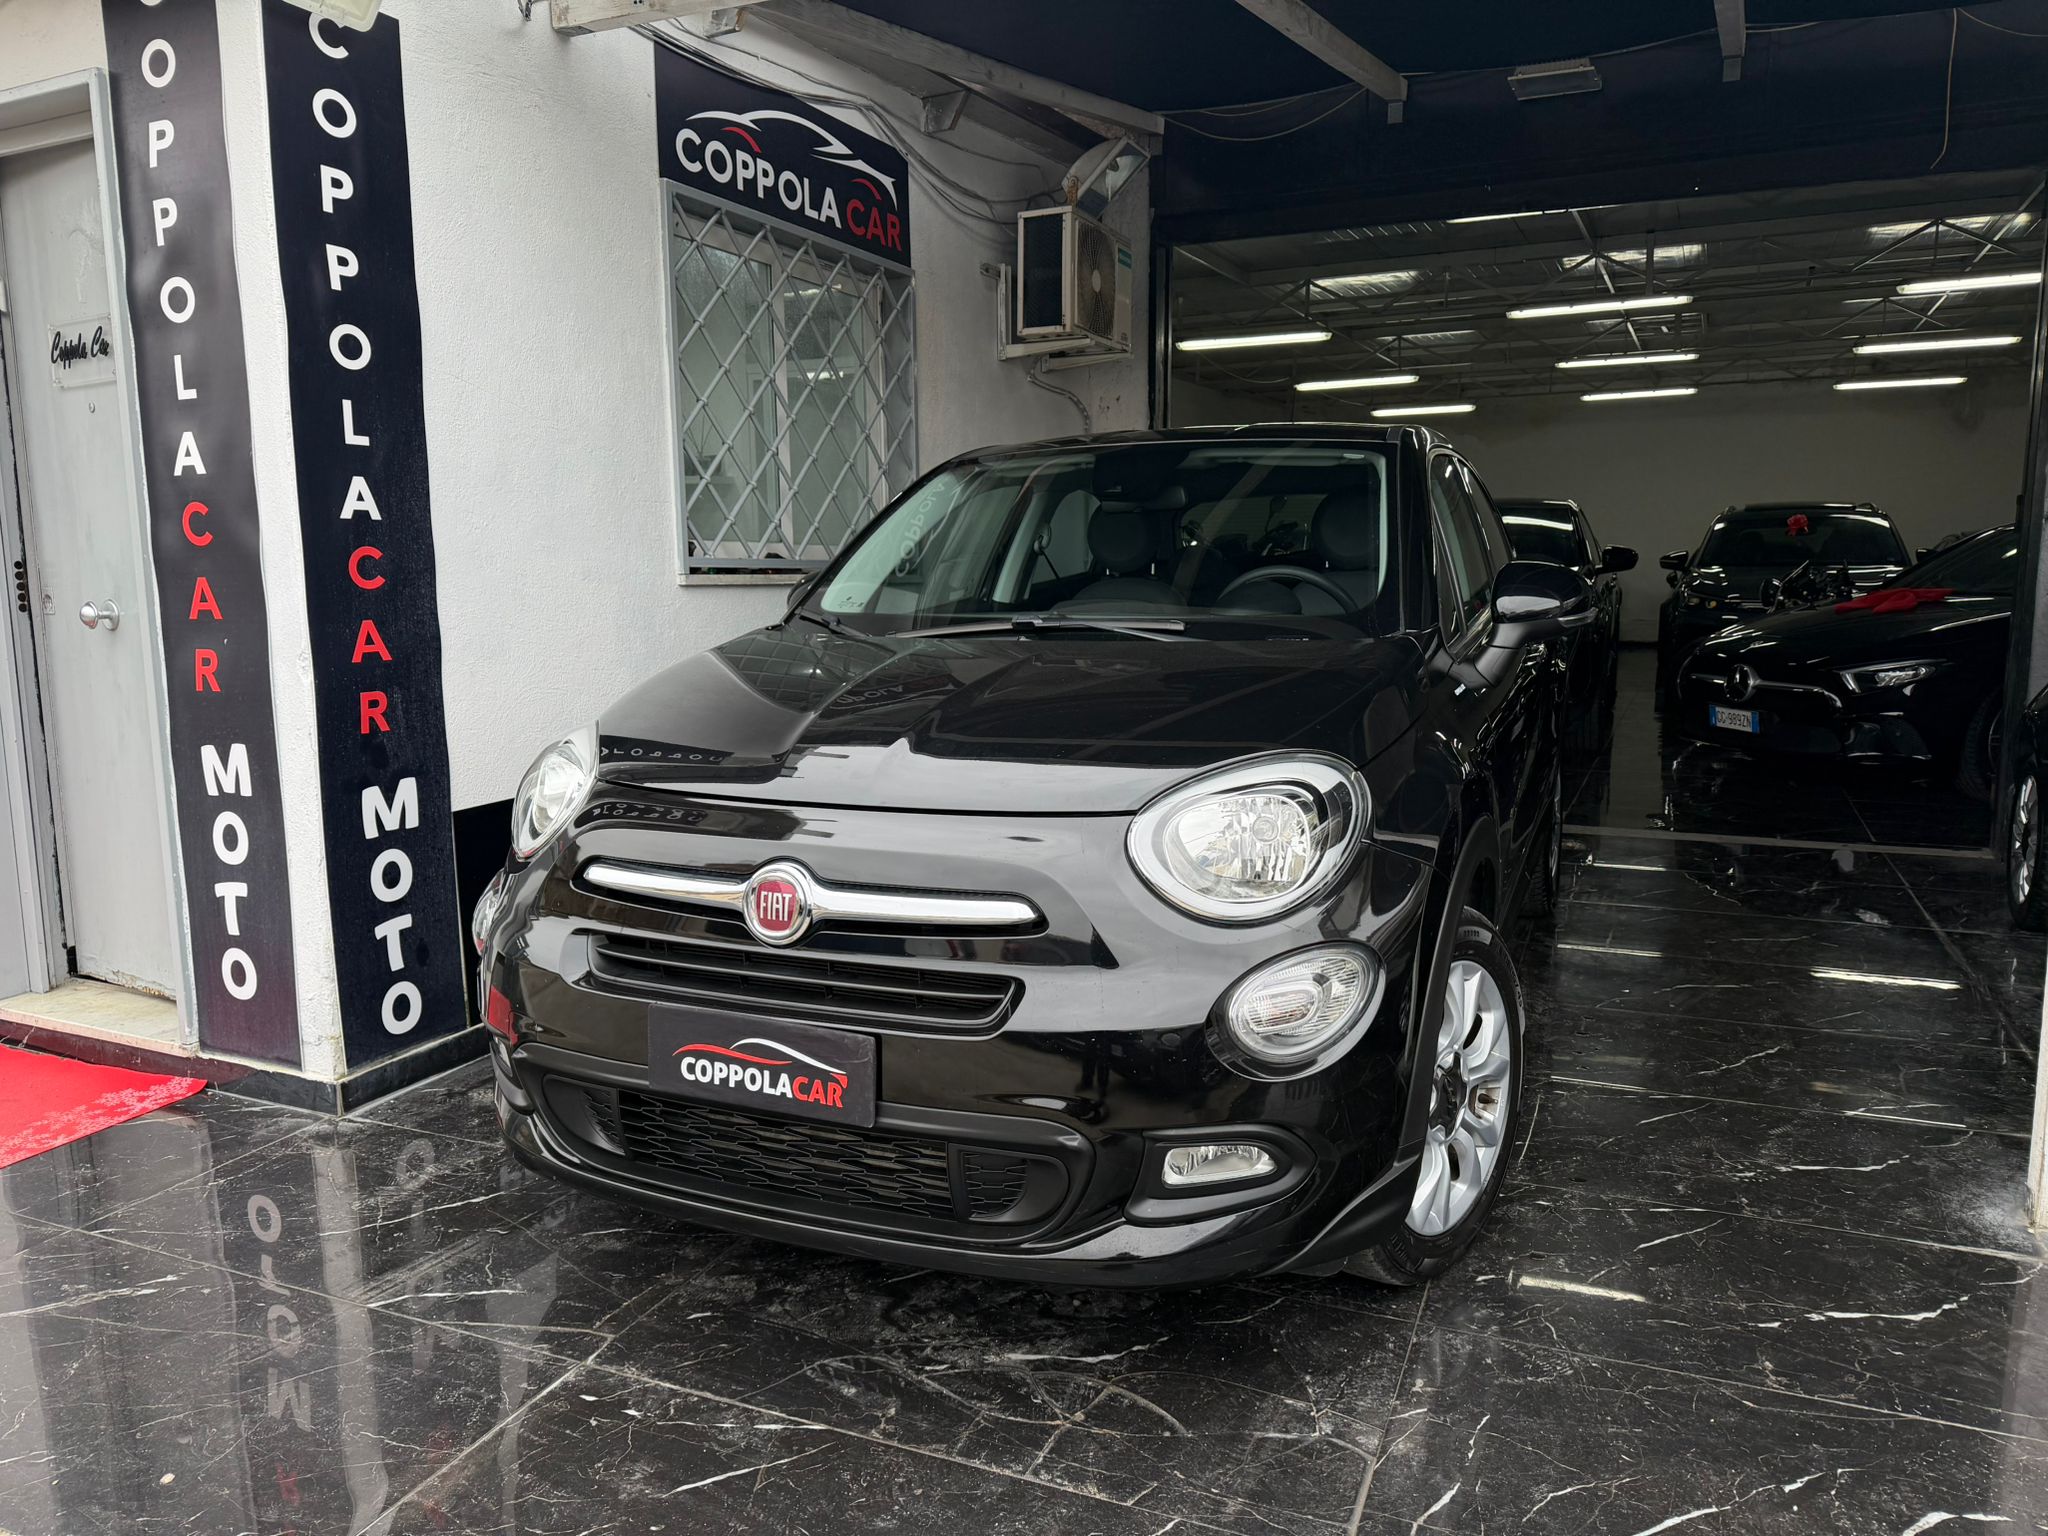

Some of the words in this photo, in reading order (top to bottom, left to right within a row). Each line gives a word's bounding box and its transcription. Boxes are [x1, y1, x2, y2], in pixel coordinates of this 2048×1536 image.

[140, 0, 206, 476] OPPOLA
[308, 12, 382, 520] COPPOLA
[675, 128, 842, 229] COPPOLA
[846, 199, 903, 252] CAR
[51, 331, 88, 370] Coppola
[182, 502, 223, 691] CAR
[348, 545, 393, 734] CAR
[201, 743, 258, 1000] MOTO
[361, 777, 422, 1035] MOTO
[759, 891, 792, 921] FIAT
